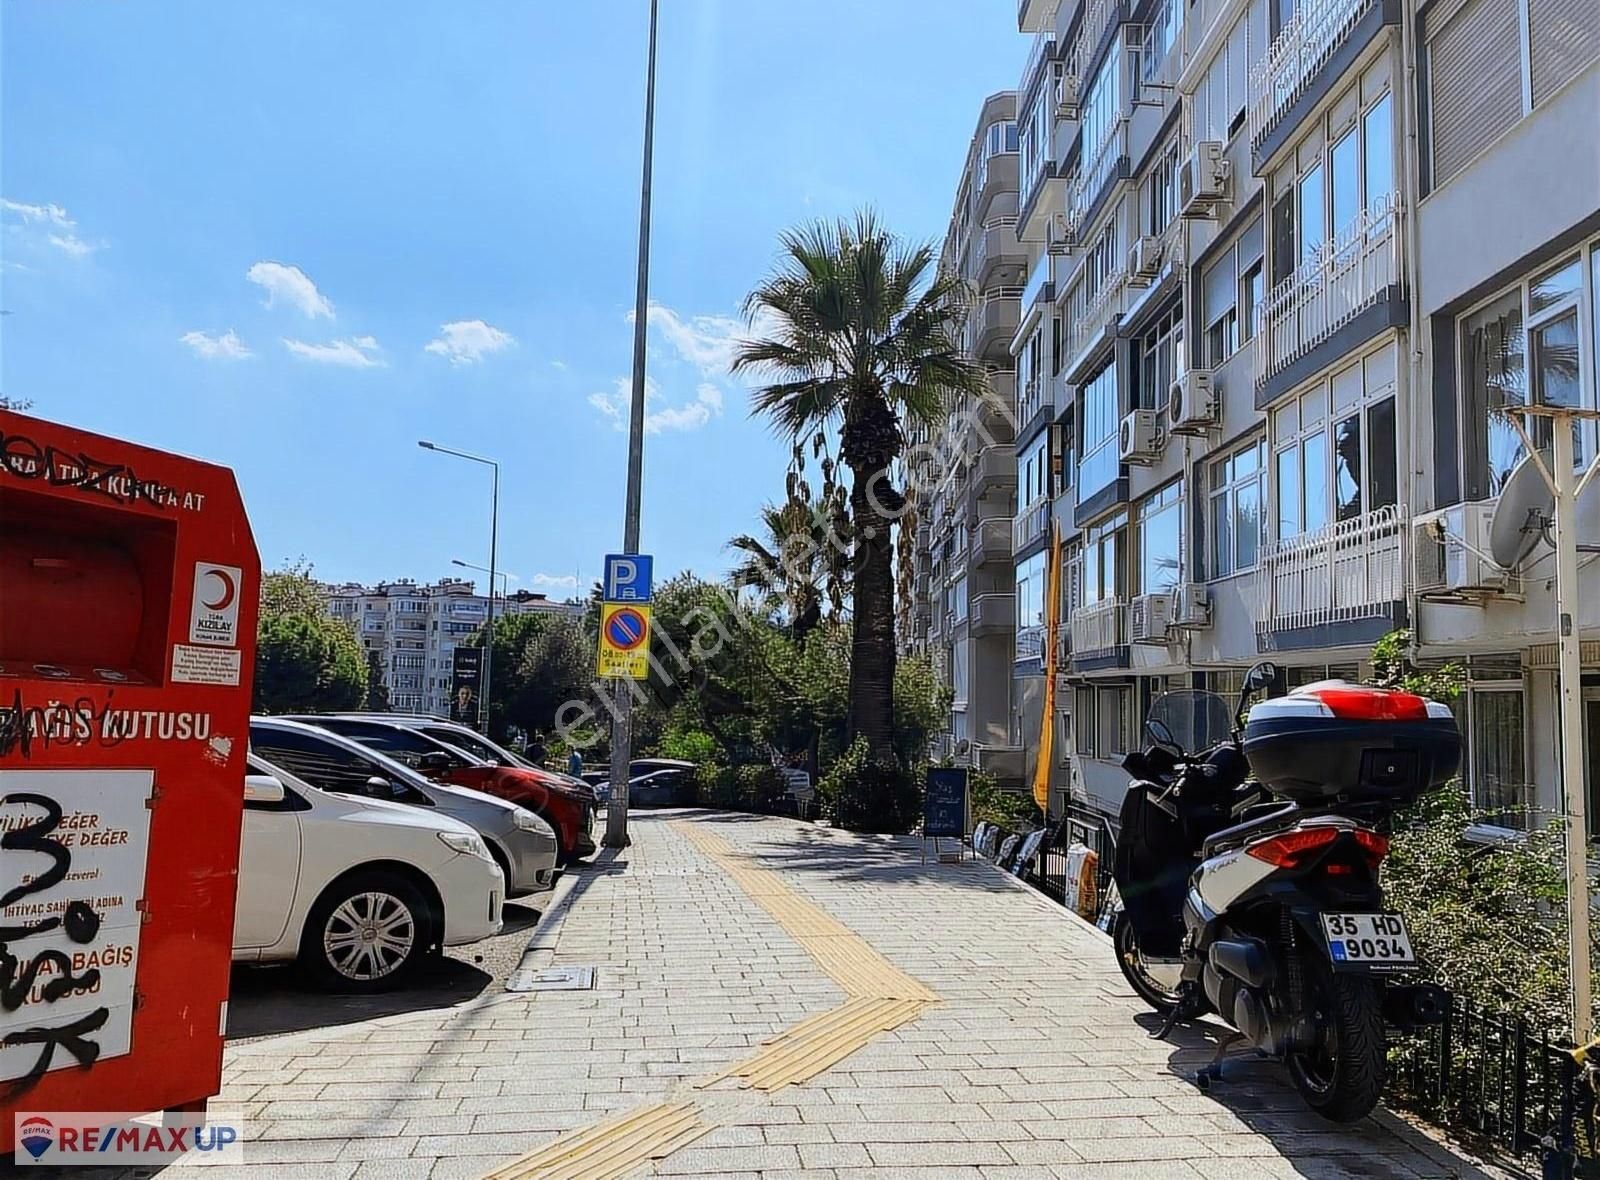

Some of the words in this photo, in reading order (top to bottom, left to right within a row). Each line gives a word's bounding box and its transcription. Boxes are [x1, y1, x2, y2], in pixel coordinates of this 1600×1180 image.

[183, 491, 205, 512] AT
[609, 559, 637, 599] P
[197, 618, 233, 631] KIZILAY
[102, 709, 210, 740] KUTUSU
[80, 827, 129, 847] DEĞER
[96, 895, 124, 909] ADINA
[1328, 916, 1358, 936] 35
[1371, 916, 1402, 936] HD
[72, 943, 134, 971] BAĞIŞ
[1346, 938, 1406, 959] 9034
